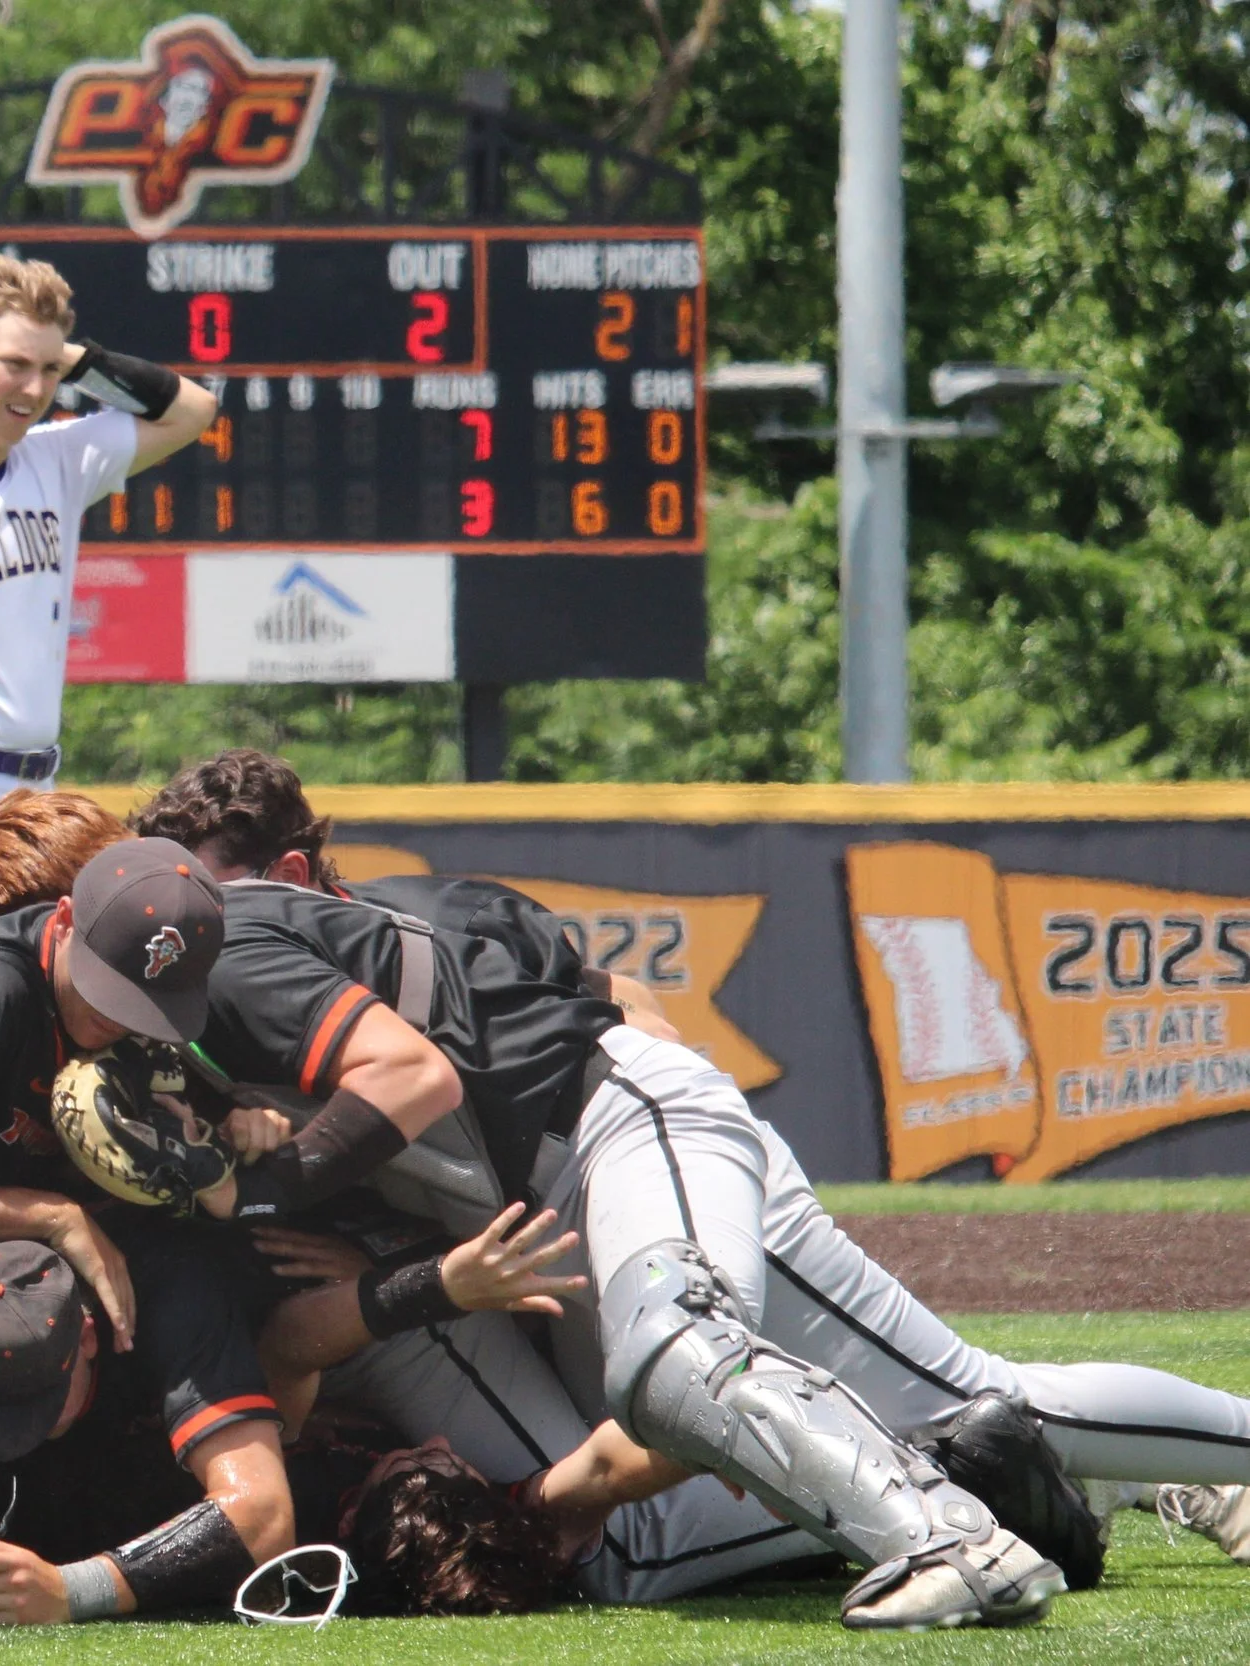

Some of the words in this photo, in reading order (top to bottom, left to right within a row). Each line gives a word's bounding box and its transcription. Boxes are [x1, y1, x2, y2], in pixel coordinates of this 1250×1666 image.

[147, 243, 275, 292] STRIKE
[388, 242, 466, 291] OUT
[527, 242, 600, 290] HOME
[603, 241, 700, 289] PITCHES
[188, 292, 232, 362] 0
[405, 290, 449, 363] 2
[412, 373, 498, 410] RUNS
[532, 368, 607, 410] HITS
[631, 368, 694, 411] ERR
[460, 409, 493, 462] 7
[552, 408, 608, 465] 13
[647, 407, 683, 466] 0
[460, 480, 495, 538] 3
[570, 480, 609, 537] 6
[647, 479, 683, 537] 0
[558, 912, 689, 990] 022
[1044, 912, 1250, 998] 2025
[1104, 1003, 1224, 1056] STATE
